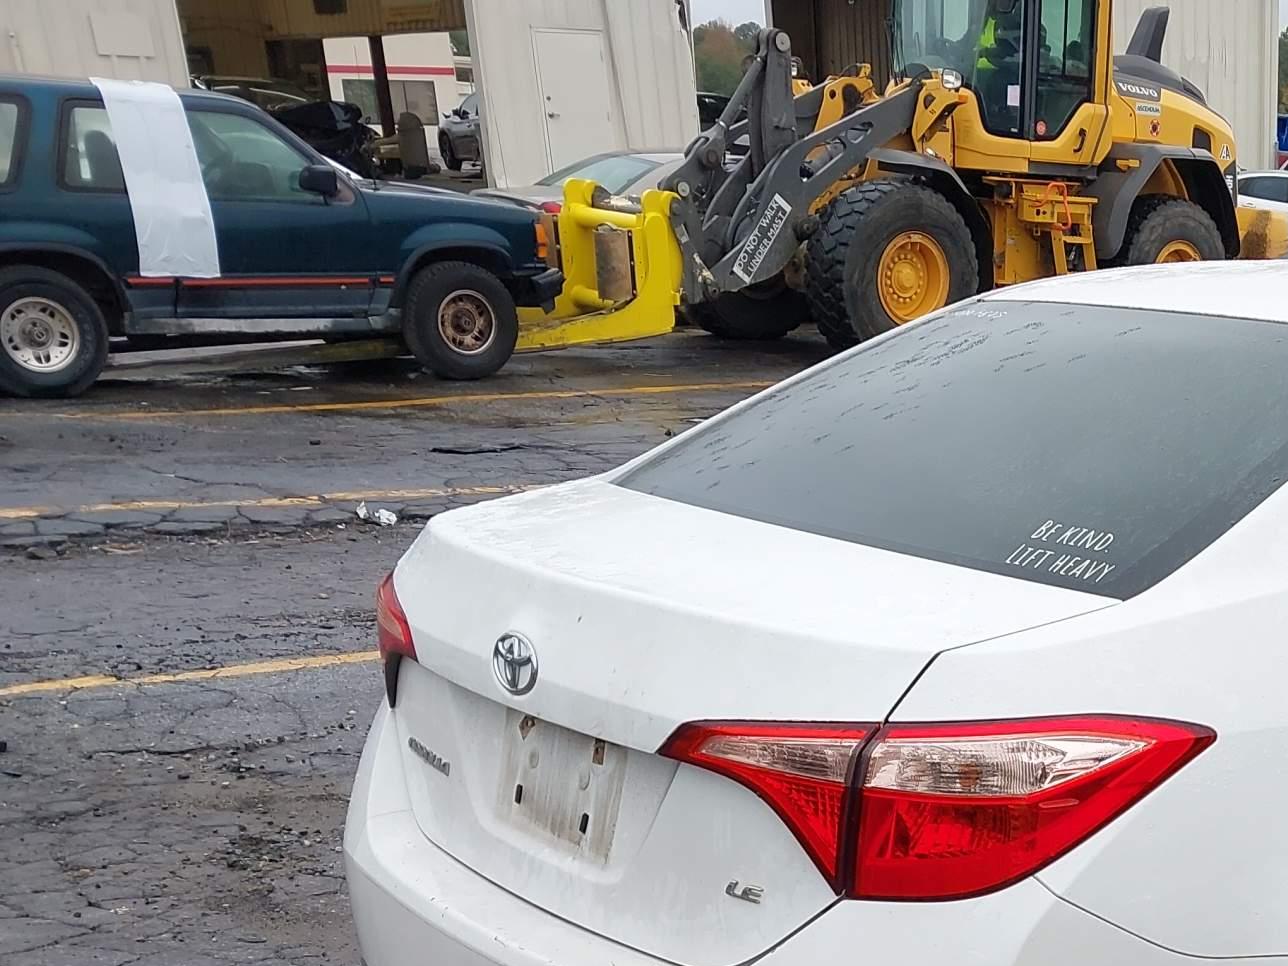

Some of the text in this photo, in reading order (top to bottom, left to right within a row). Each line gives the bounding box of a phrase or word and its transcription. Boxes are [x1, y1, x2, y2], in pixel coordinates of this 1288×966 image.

[1118, 82, 1158, 98] VOLVO
[737, 199, 779, 270] DO NOT WALK
[748, 211, 785, 272] UNDER MAST
[1031, 519, 1063, 542] BE
[1005, 543, 1116, 583] LIFT HEAVY
[725, 880, 765, 905] LE
